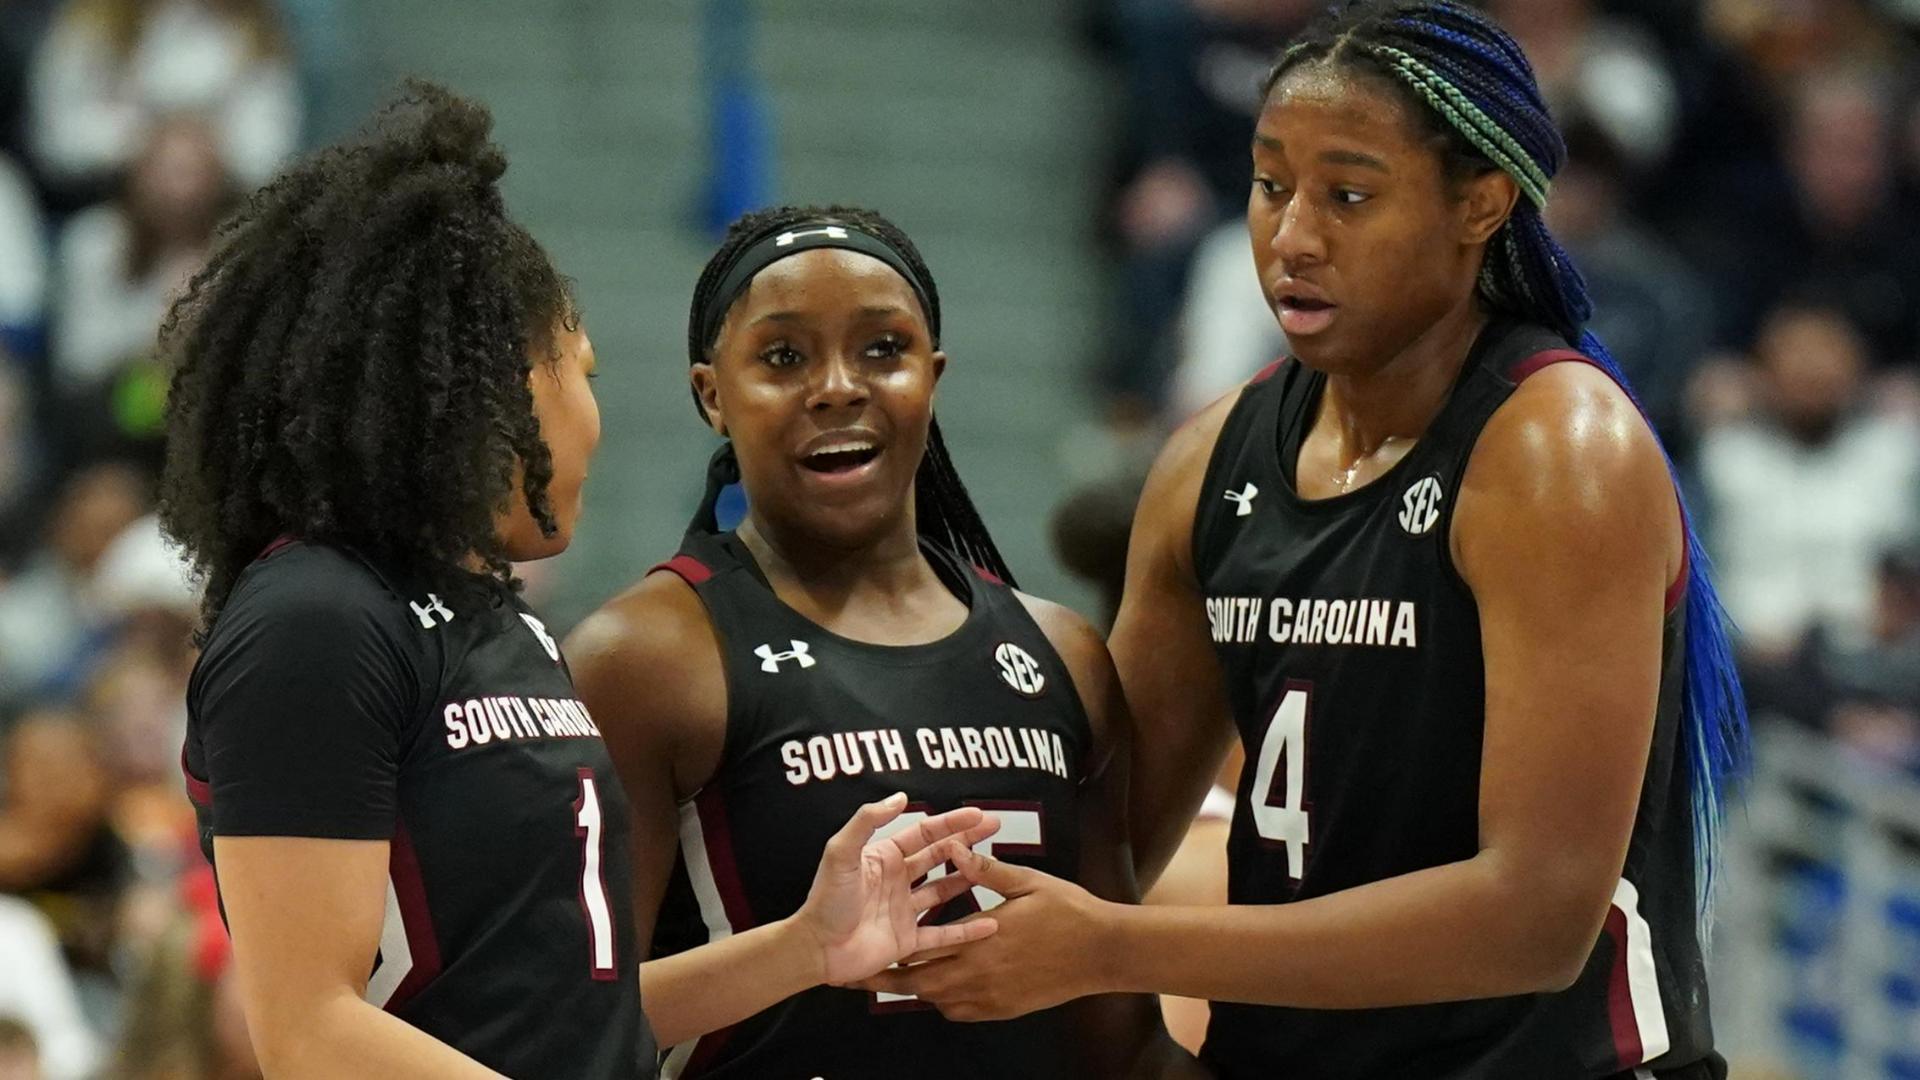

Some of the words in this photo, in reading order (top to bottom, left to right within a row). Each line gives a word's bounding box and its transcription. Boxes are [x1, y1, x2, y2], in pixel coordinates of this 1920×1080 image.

[1398, 476, 1443, 535] SEC
[1206, 597, 1262, 643] SOUTH
[1268, 597, 1417, 648] CAROLINA
[995, 643, 1045, 694] SEC
[443, 696, 541, 749] SOUTH
[527, 697, 602, 738] CAROLI
[780, 728, 911, 785] SOUTH
[915, 726, 1069, 779] CAROLINA
[1249, 684, 1311, 882] 4
[574, 773, 616, 974] 1
